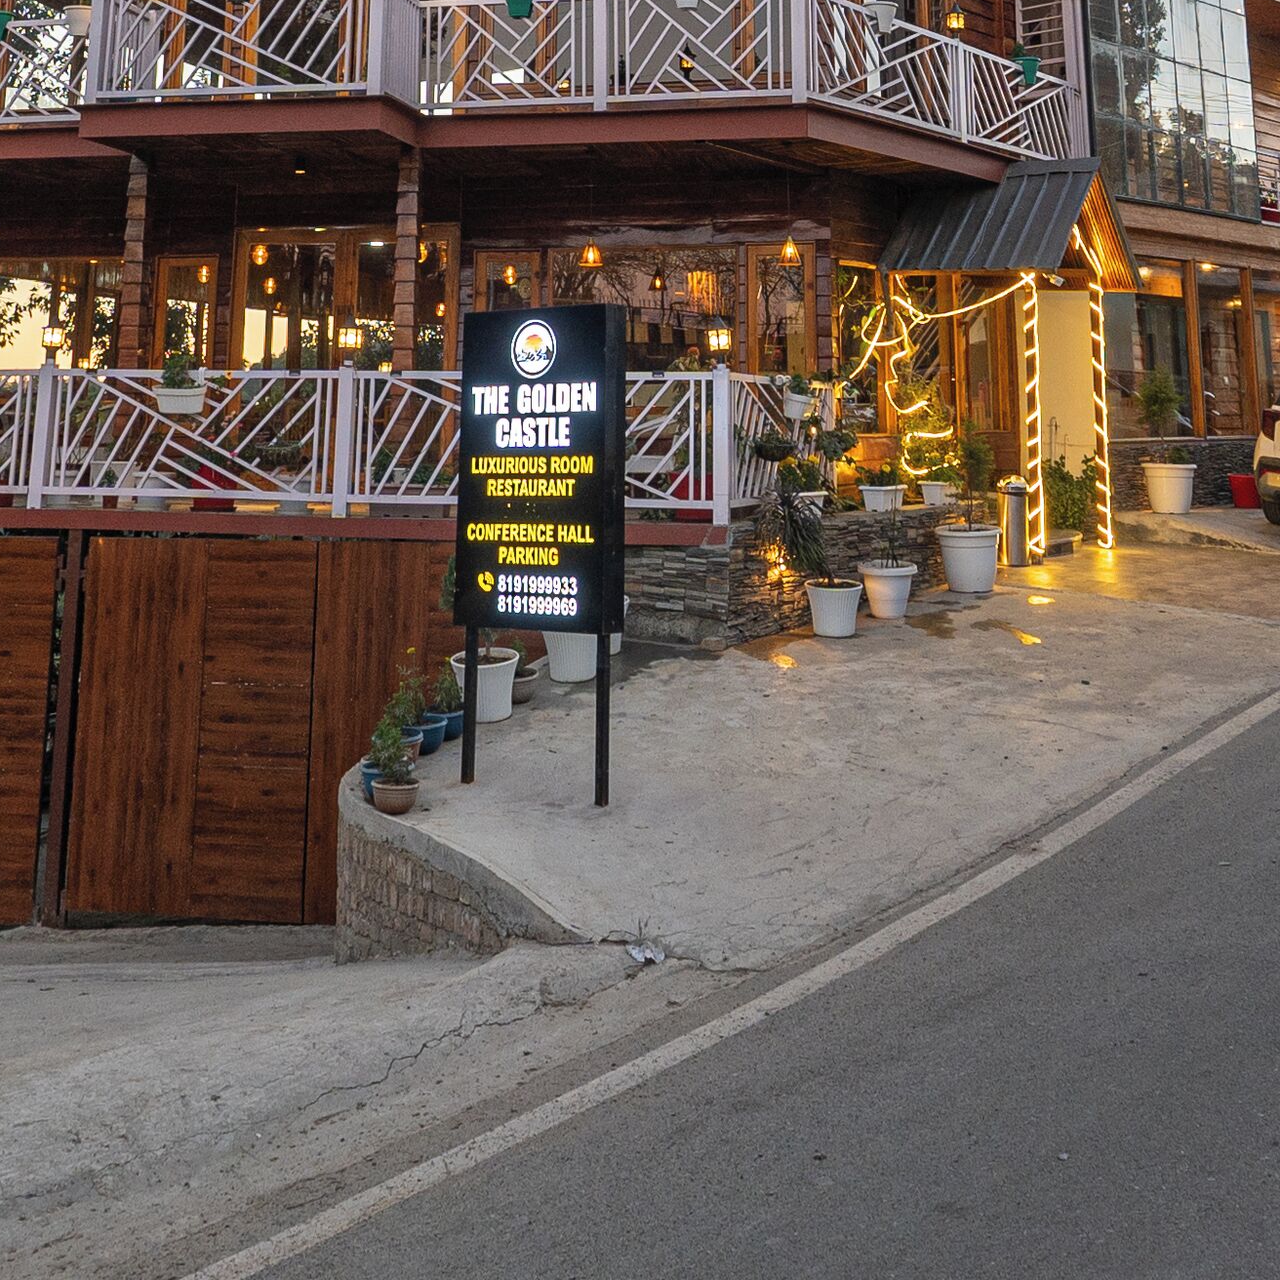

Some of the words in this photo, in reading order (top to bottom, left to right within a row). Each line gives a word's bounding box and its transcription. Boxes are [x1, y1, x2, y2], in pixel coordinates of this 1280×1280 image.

[472, 385, 510, 415] THE
[517, 382, 597, 414] GOLDEN
[495, 416, 571, 448] CASTLE
[471, 456, 547, 474] LUXURIOUS
[550, 455, 594, 474] ROOM
[486, 478, 576, 497] RESTAURANT
[466, 523, 555, 542] CONFERENCE
[557, 524, 595, 544] HALL
[498, 545, 559, 566] PARKING
[497, 573, 578, 596] 8191999933
[497, 594, 578, 617] 8191999969
